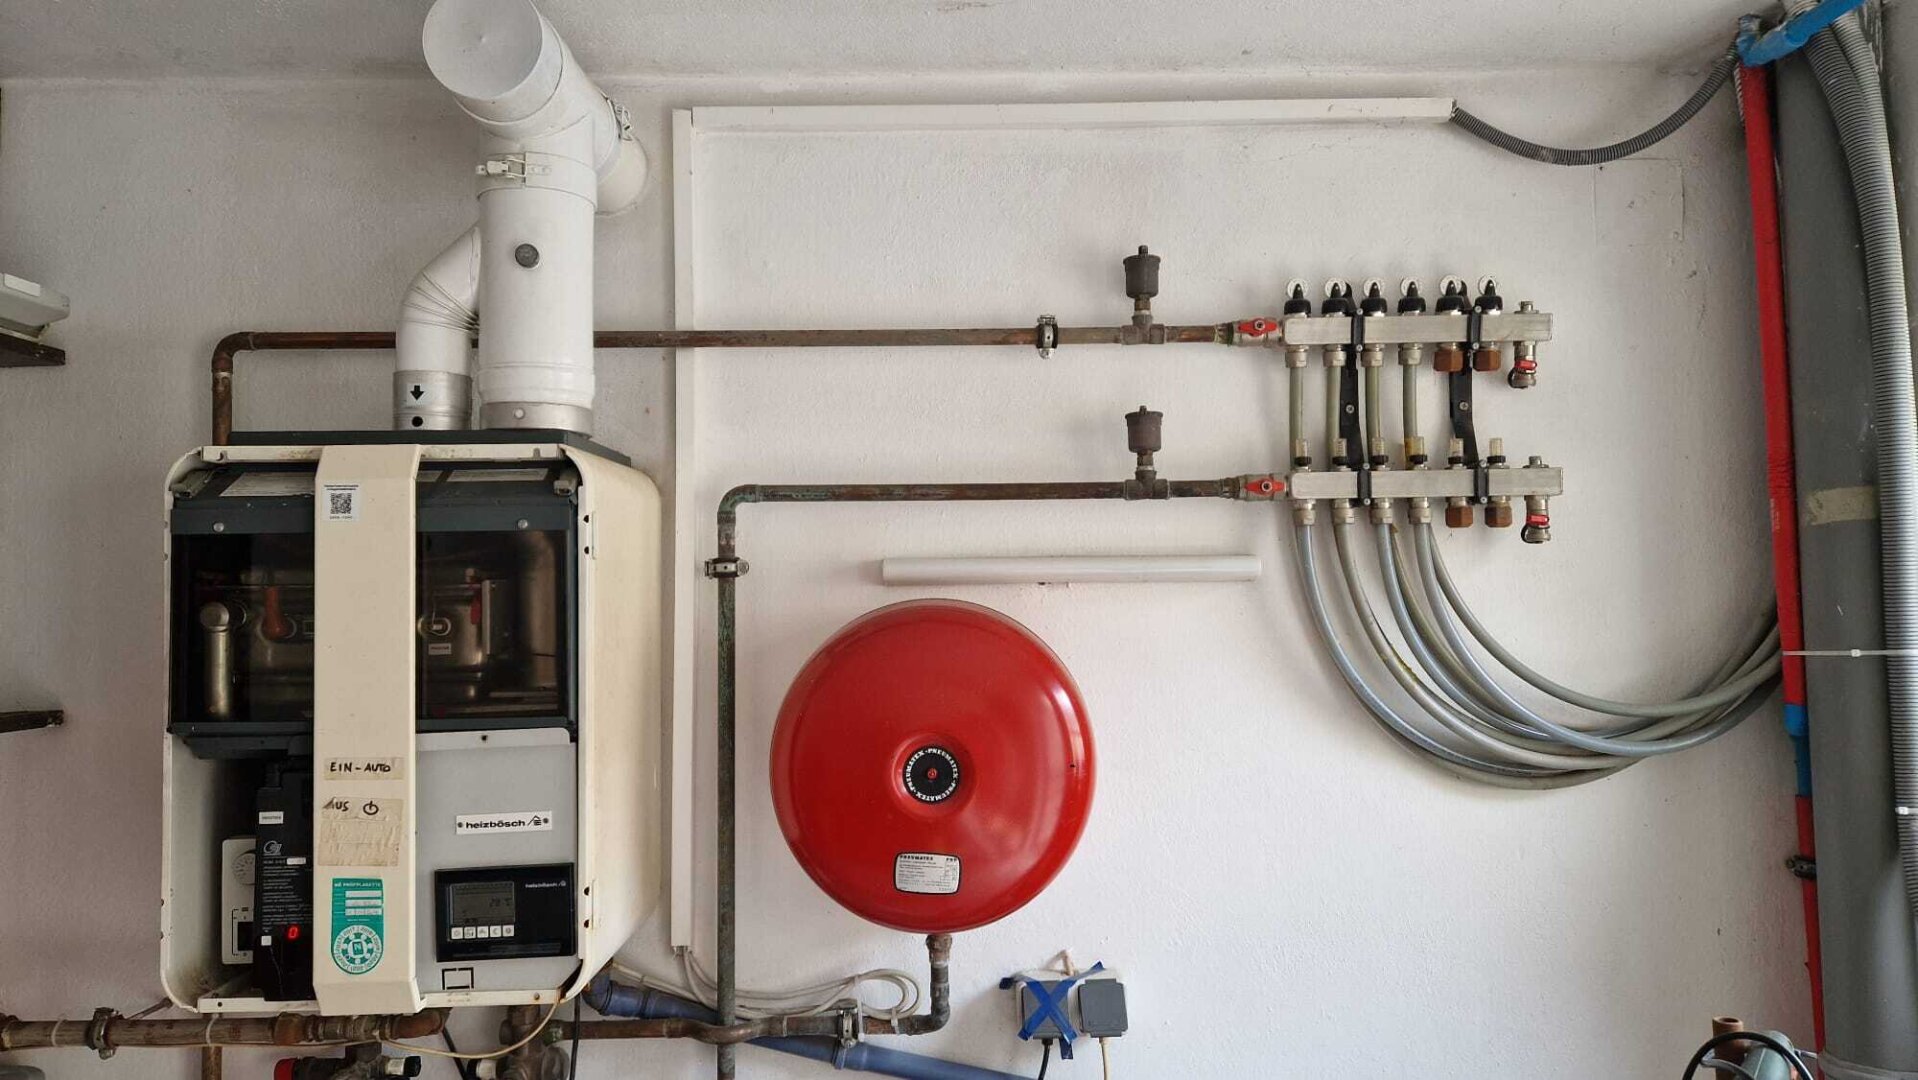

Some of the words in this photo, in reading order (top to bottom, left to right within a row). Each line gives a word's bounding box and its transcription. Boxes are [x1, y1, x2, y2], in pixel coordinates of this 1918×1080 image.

[330, 762, 352, 773] EIN
[364, 762, 391, 773] AUTO
[466, 819, 525, 829] heizbösch
